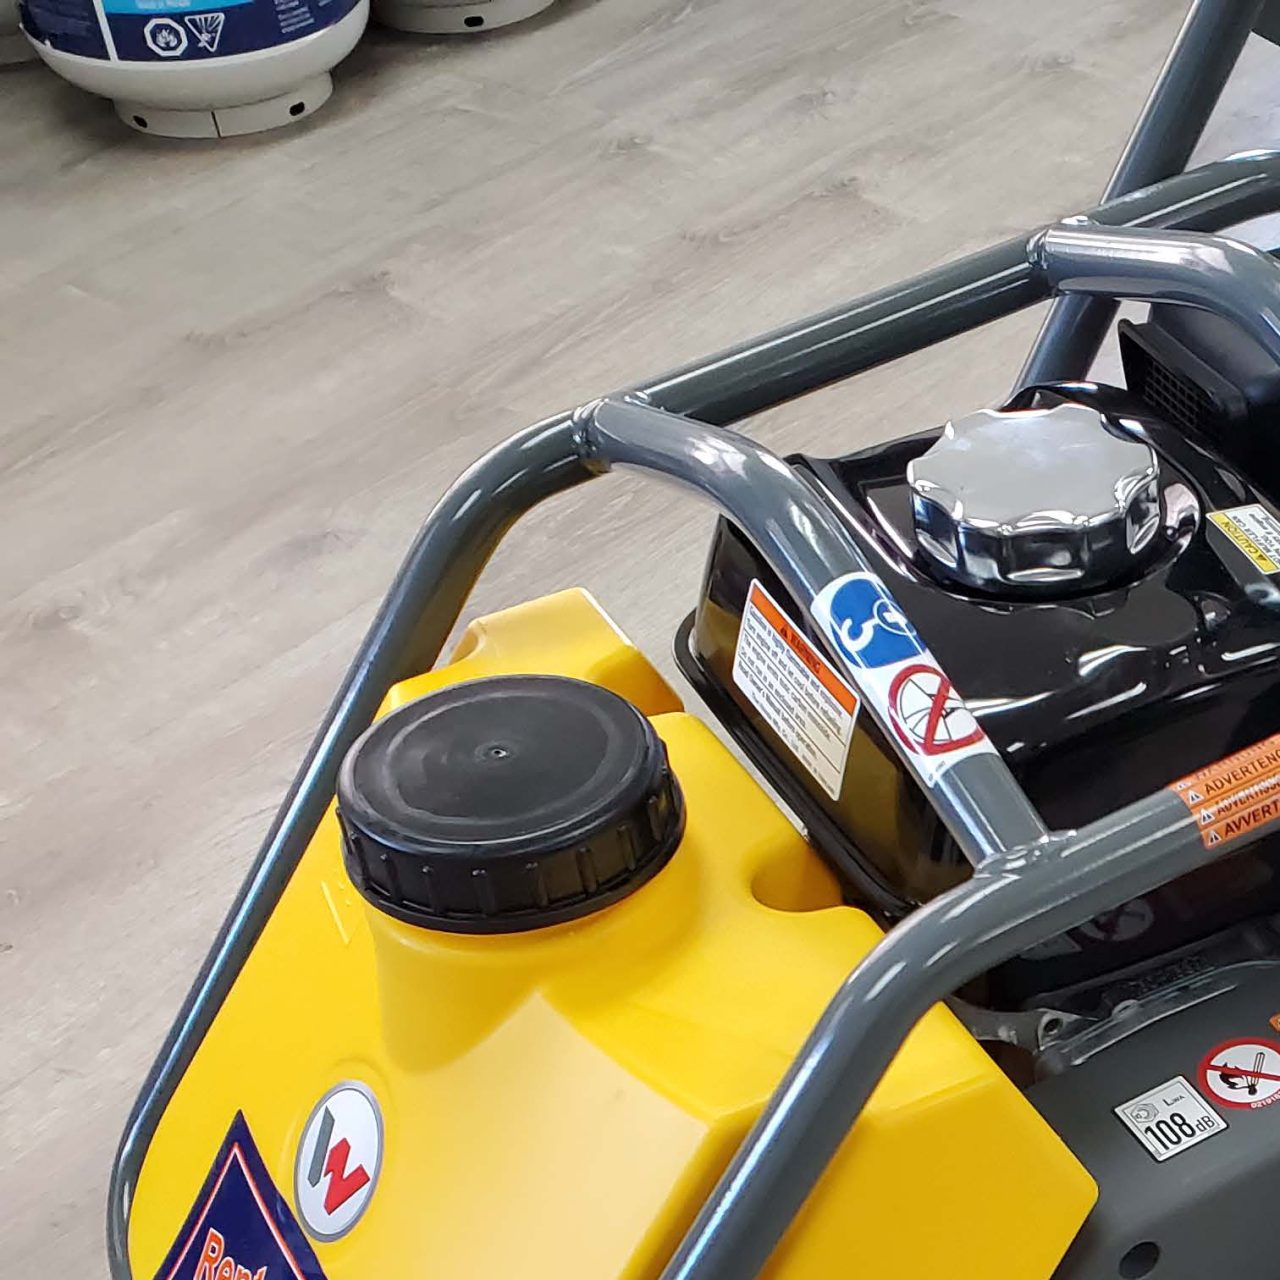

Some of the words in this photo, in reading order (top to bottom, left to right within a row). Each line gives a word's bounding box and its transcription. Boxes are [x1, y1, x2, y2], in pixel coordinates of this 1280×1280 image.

[1219, 521, 1260, 554] CAUTION
[1144, 1112, 1196, 1150] 108
[1196, 1115, 1215, 1133] dB
